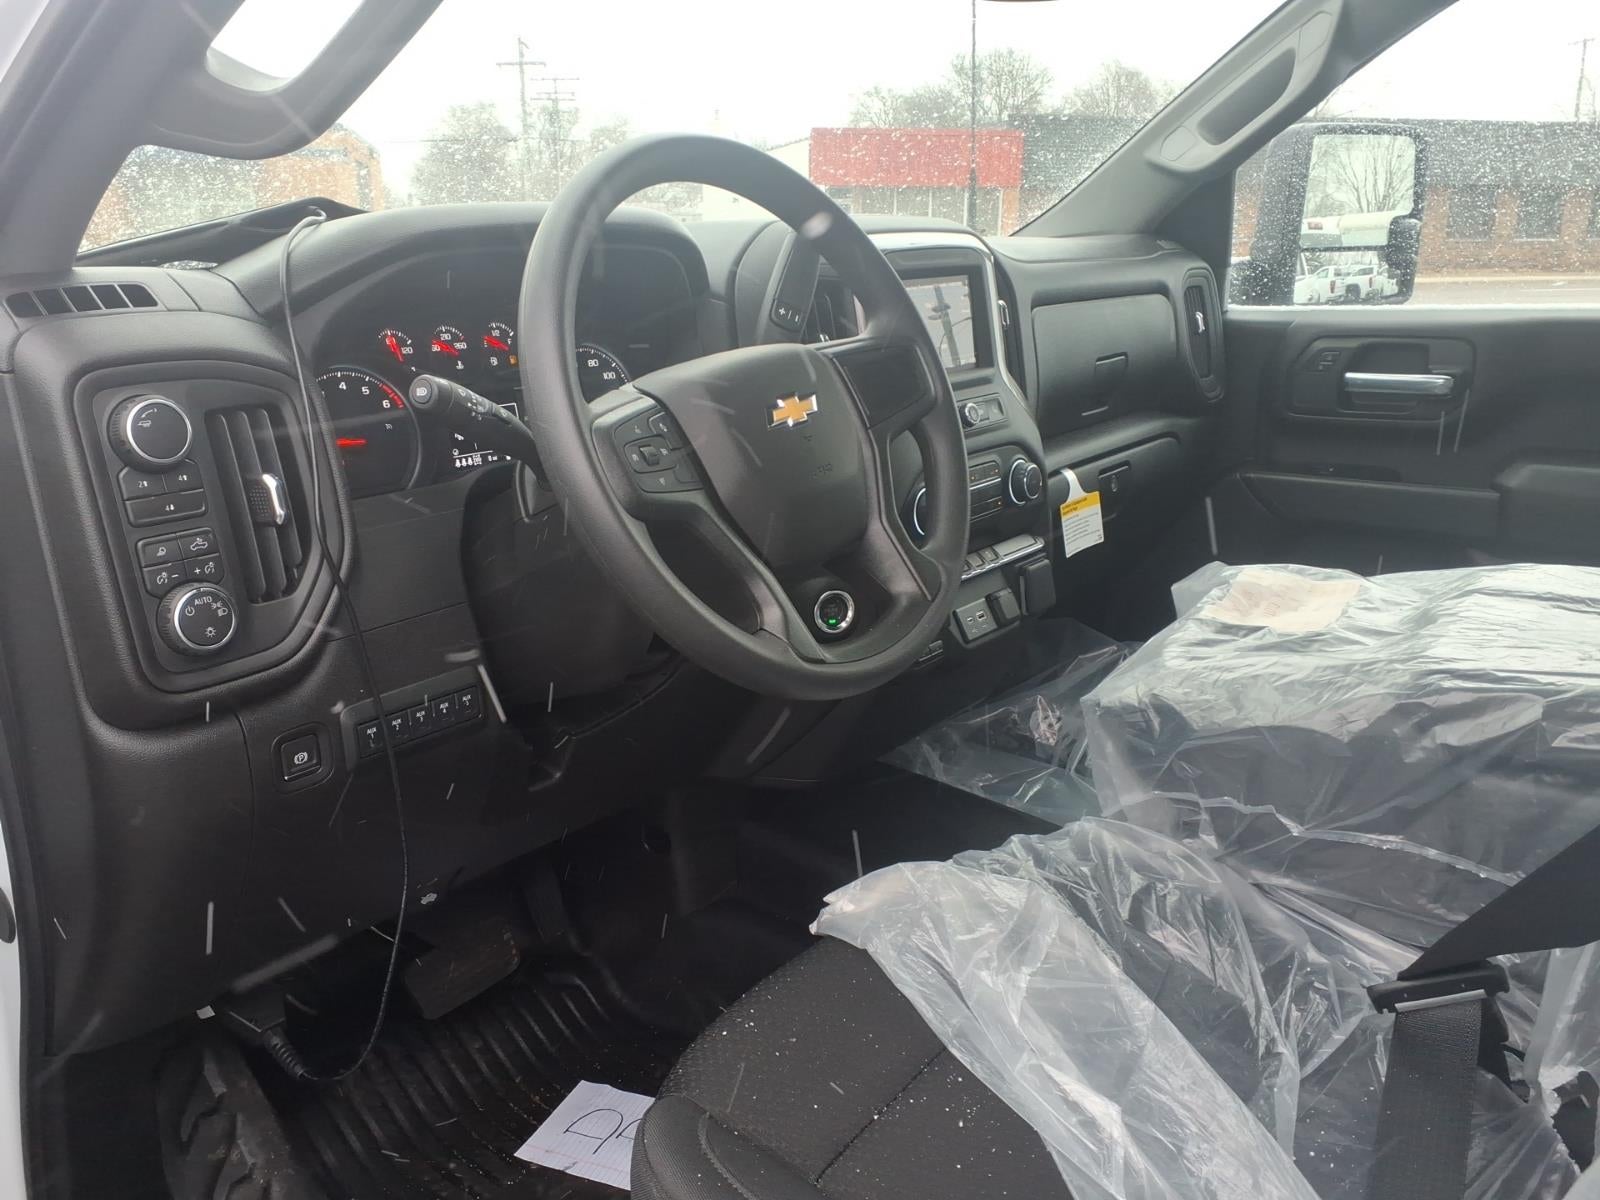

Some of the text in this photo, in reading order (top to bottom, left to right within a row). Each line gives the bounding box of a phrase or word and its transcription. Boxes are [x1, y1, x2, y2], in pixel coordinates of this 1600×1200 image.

[587, 359, 599, 367] 80
[603, 371, 616, 380] 100
[338, 382, 347, 390] 4
[361, 386, 370, 395] 5
[382, 399, 391, 408] 6
[194, 596, 212, 606] AUTO
[462, 694, 472, 702] AUX
[440, 702, 449, 710] AUX
[391, 718, 402, 726] AUX
[366, 727, 377, 735] AUX
